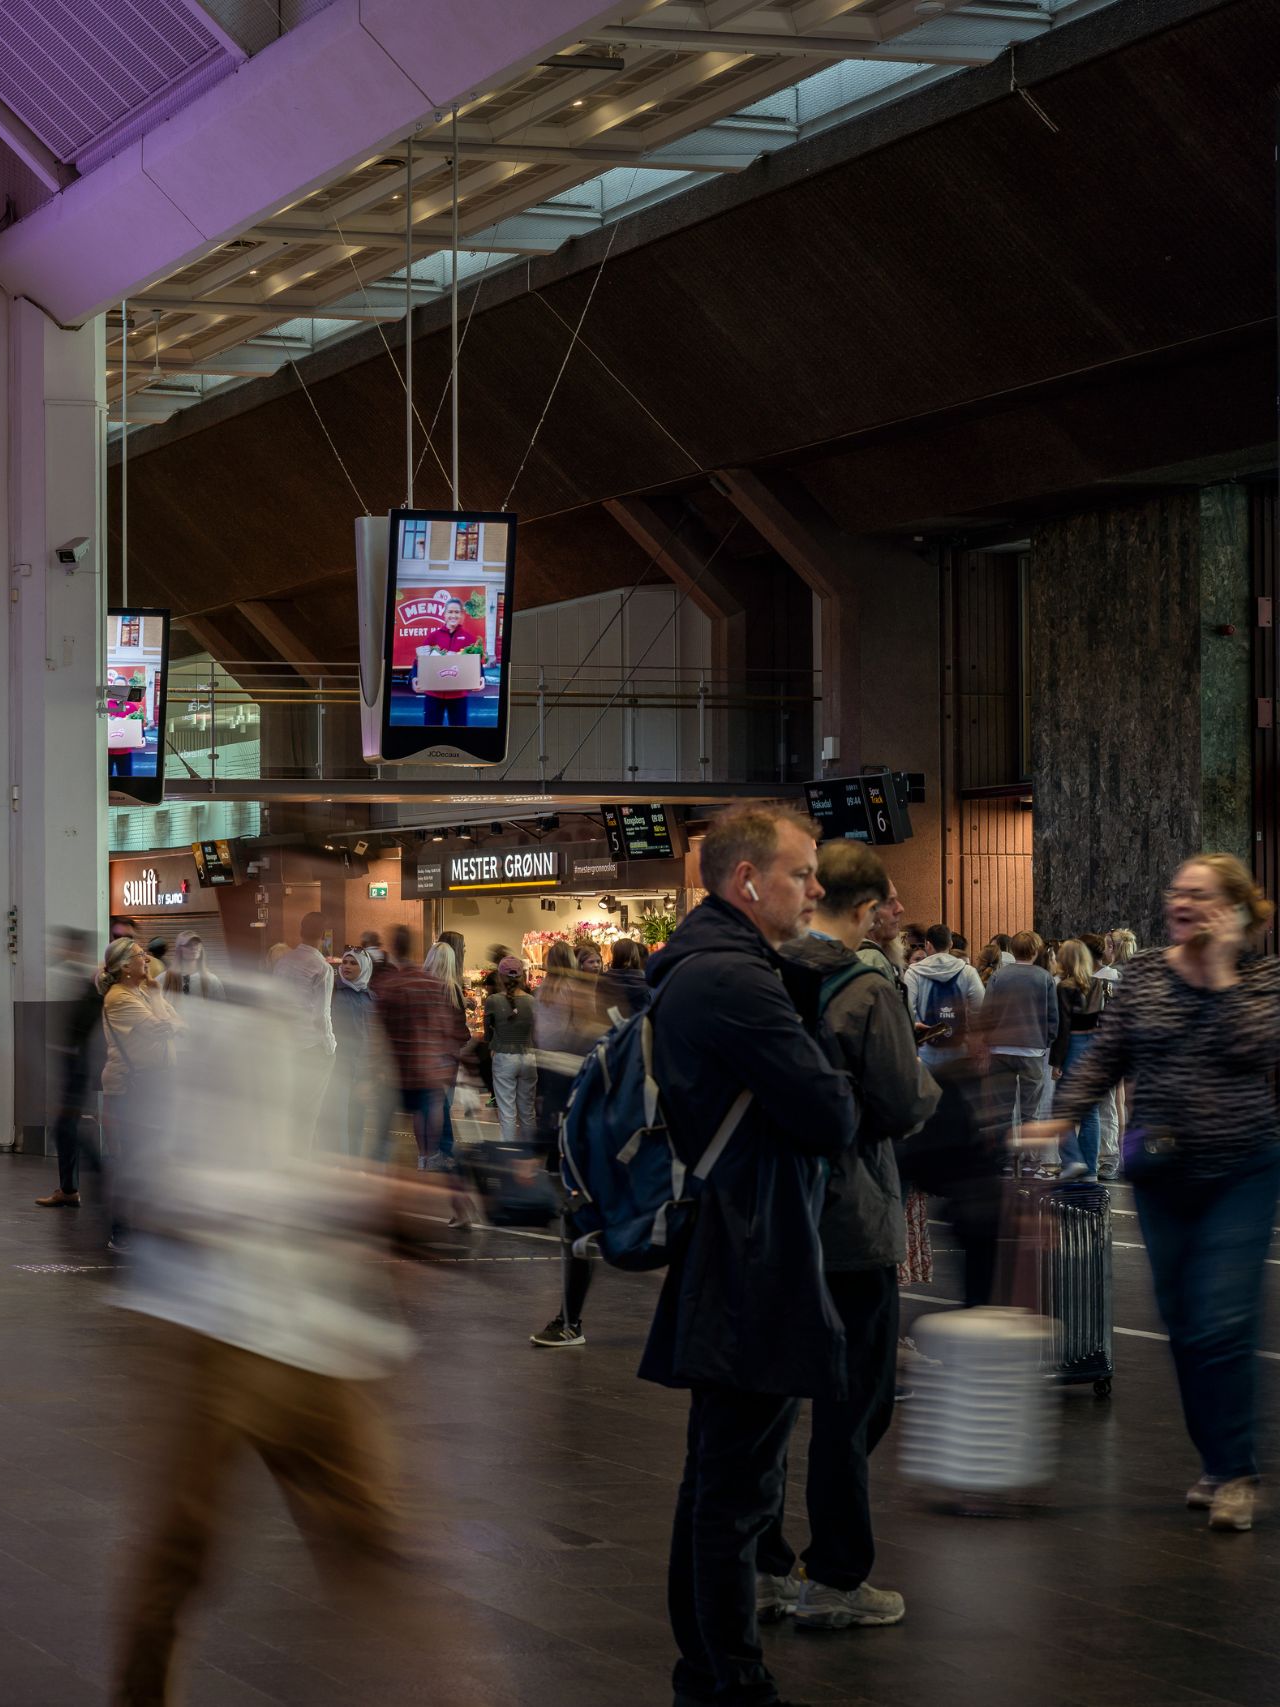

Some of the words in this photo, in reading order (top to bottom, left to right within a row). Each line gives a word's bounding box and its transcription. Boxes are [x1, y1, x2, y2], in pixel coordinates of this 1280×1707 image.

[399, 627, 428, 637] LEVERT
[427, 751, 460, 759] JCDecaux
[876, 810, 886, 832] 6
[611, 832, 620, 851] 5
[451, 855, 498, 881] MESTER
[504, 852, 553, 878] GRØNN
[123, 868, 158, 907] swift
[157, 894, 165, 905] BY
